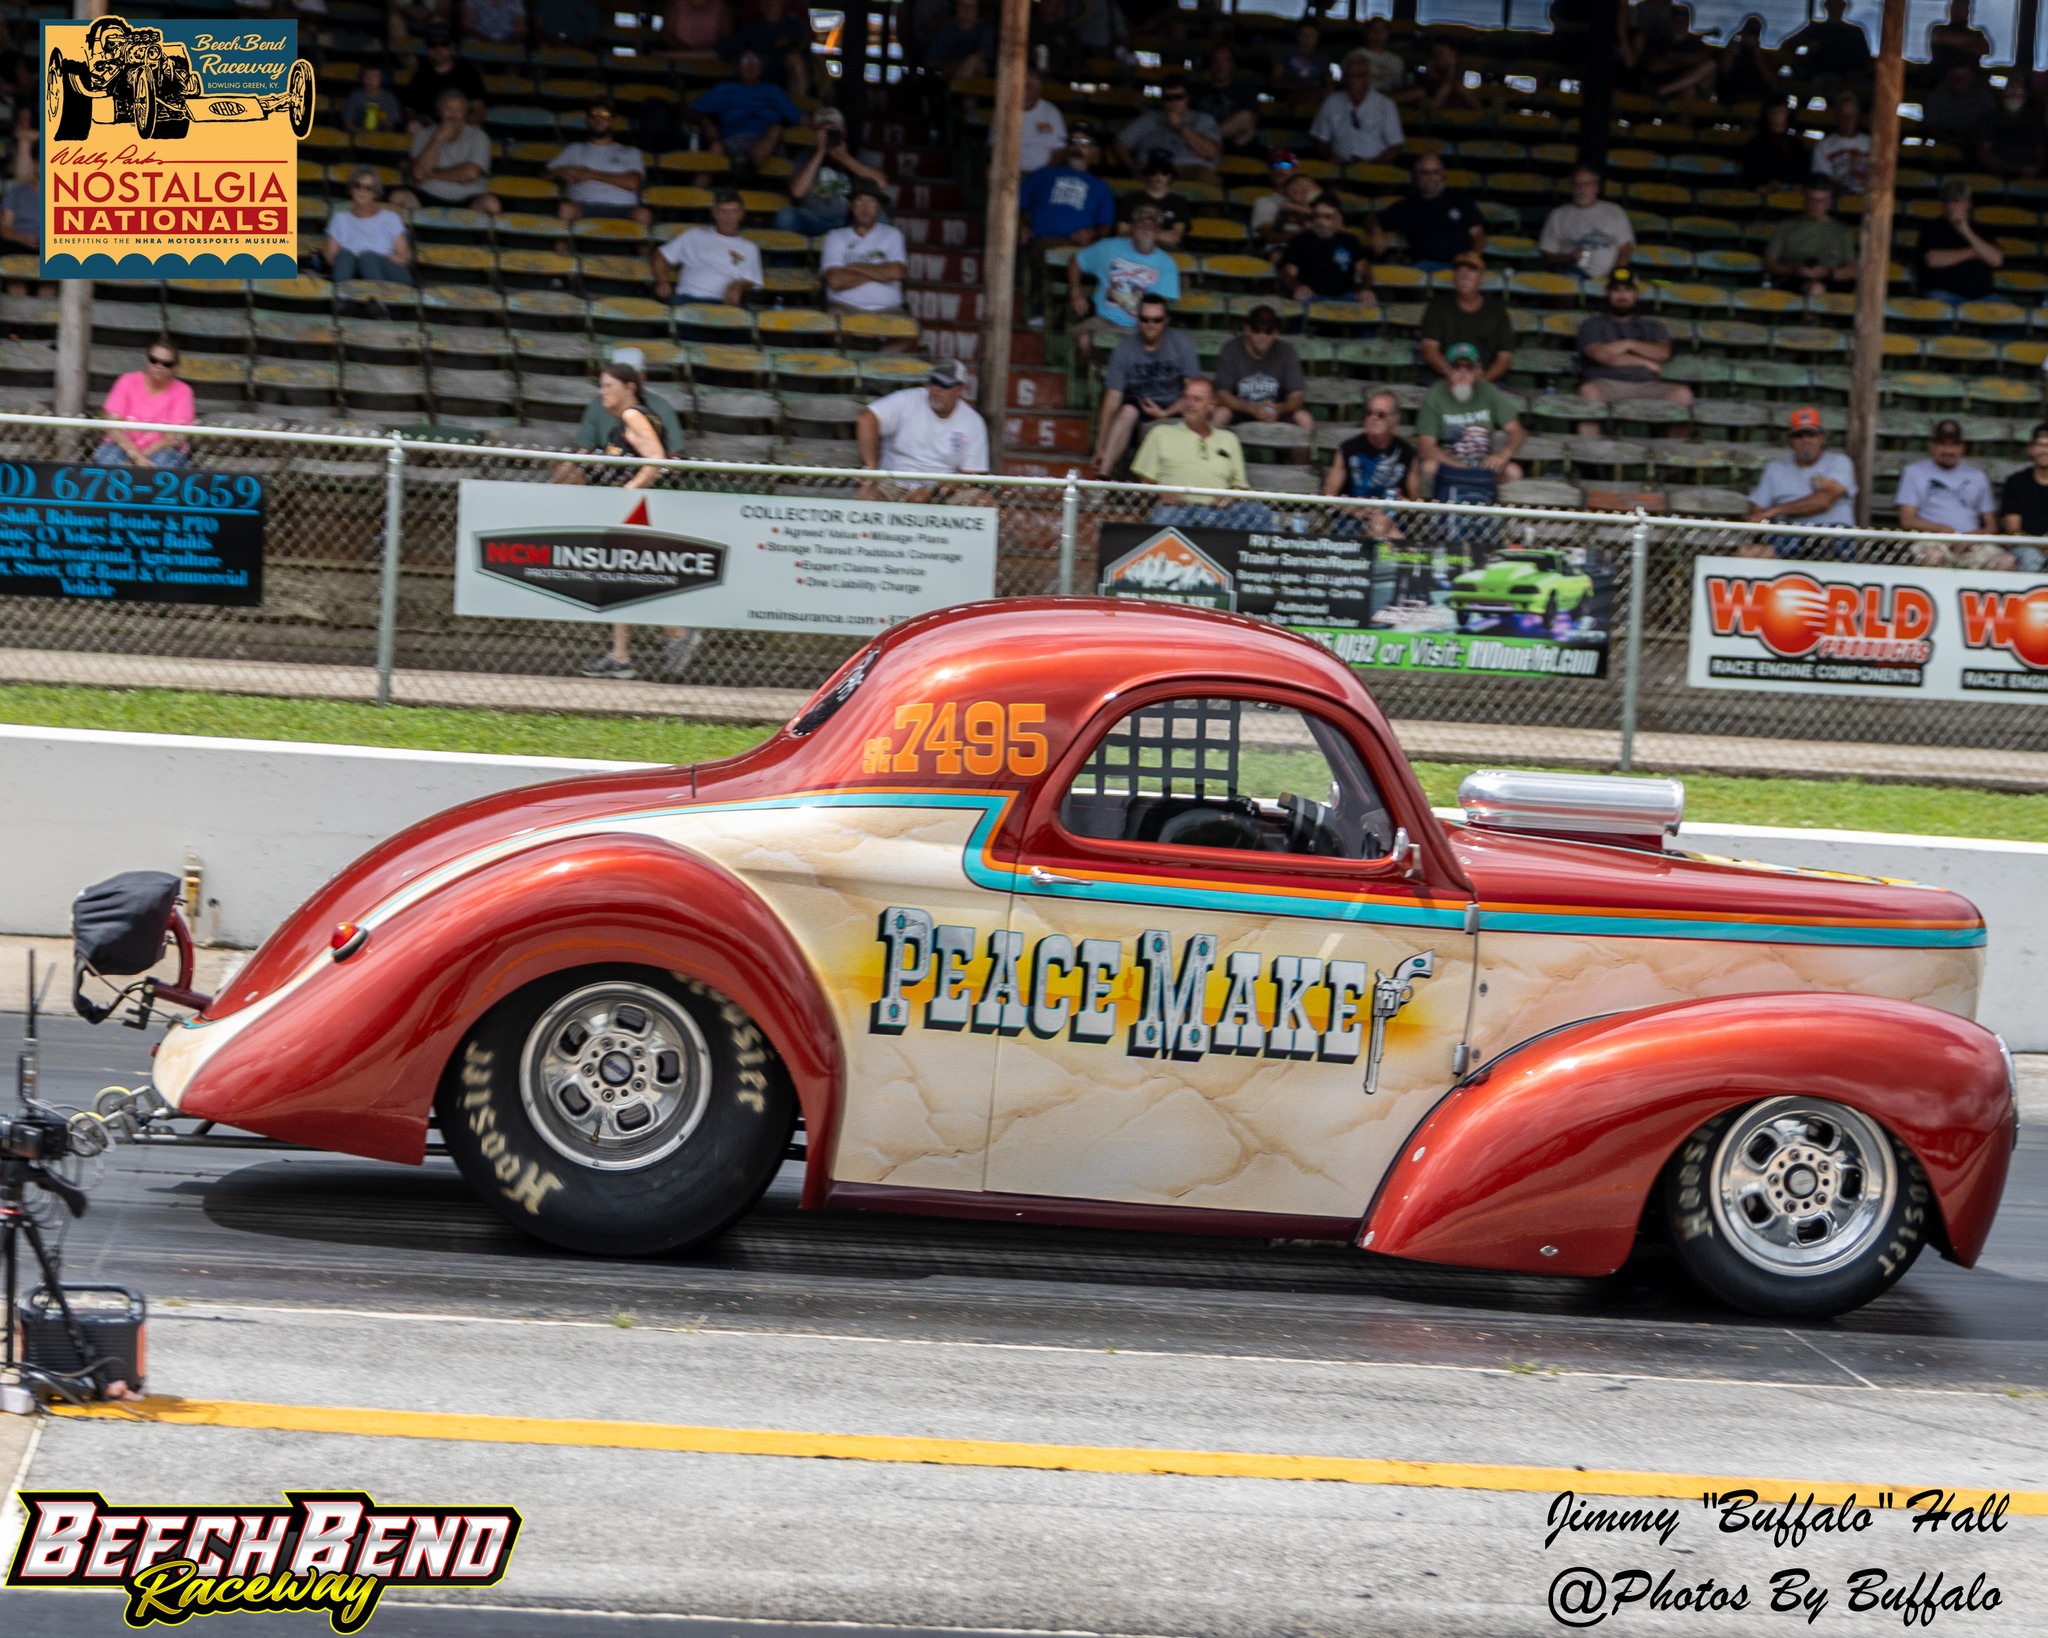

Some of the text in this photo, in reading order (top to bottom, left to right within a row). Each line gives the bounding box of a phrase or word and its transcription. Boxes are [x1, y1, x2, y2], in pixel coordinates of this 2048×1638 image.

[1017, 378, 1036, 406] 6
[1038, 419, 1056, 446] 5
[51, 467, 262, 509] 678-2659
[182, 515, 220, 535] PTO
[740, 504, 986, 531] COLLECTOR CAR INSURANCE
[783, 525, 949, 545] Agreed Value Mileage Plans
[1248, 533, 1270, 547] RV
[486, 540, 716, 575] NCM INSURANCE
[767, 542, 963, 564] Storage Transit Paddock Coverage
[1237, 549, 1279, 565] Trailer
[525, 566, 592, 580] PROTECTING
[595, 570, 623, 582] YOUR
[801, 560, 926, 576] Expert Claims Service
[805, 576, 922, 593] One Liability Charge
[748, 608, 876, 626] ncminsurance.com
[1706, 572, 1937, 656] WORLD
[1380, 642, 1408, 664] or
[1818, 637, 1932, 664] PRODUCTS
[1711, 658, 1922, 684] RACE ENGINE COMPONENTS
[1963, 671, 2007, 689] RACE
[892, 701, 1048, 776] 7495
[868, 906, 1368, 1064] PEACE MAKE
